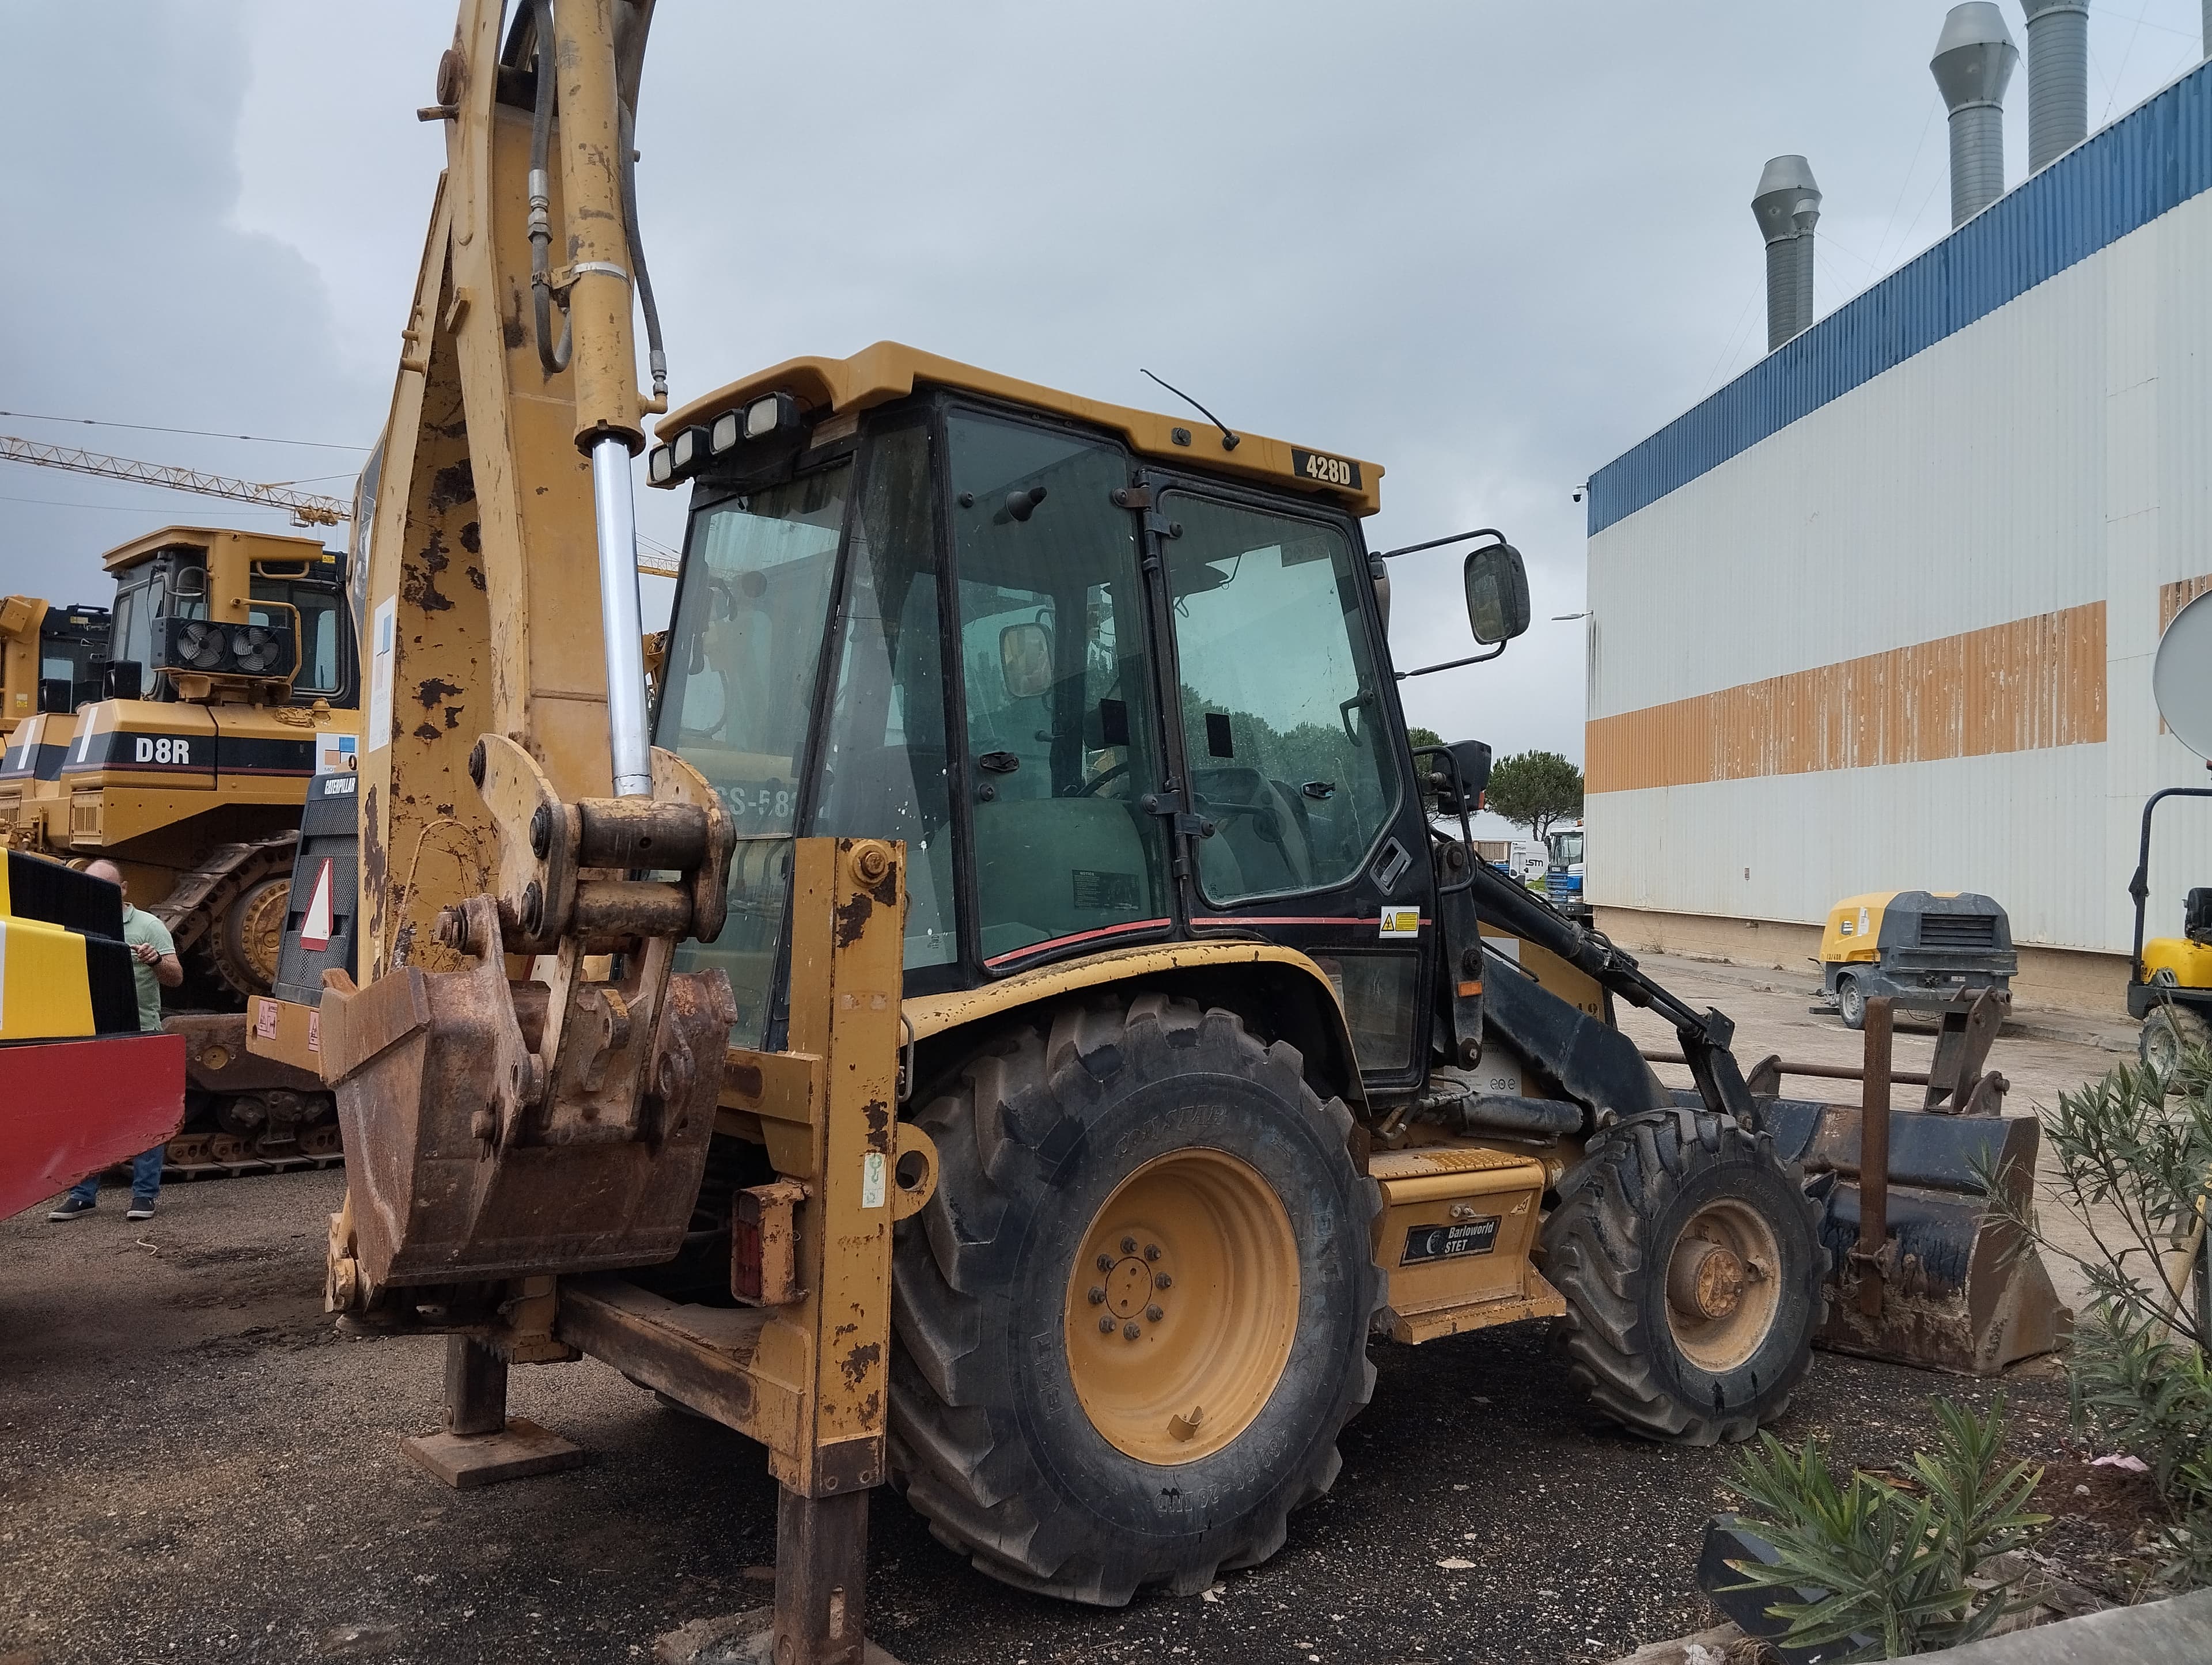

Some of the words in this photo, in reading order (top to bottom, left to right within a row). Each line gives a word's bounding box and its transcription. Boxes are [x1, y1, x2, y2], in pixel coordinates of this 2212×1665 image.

[1306, 454, 1351, 485] 428D
[136, 737, 190, 764] D8R
[324, 777, 356, 795] CATERPILLAR
[1448, 1222, 1494, 1239] Barloworld
[1444, 1239, 1468, 1254] STET
